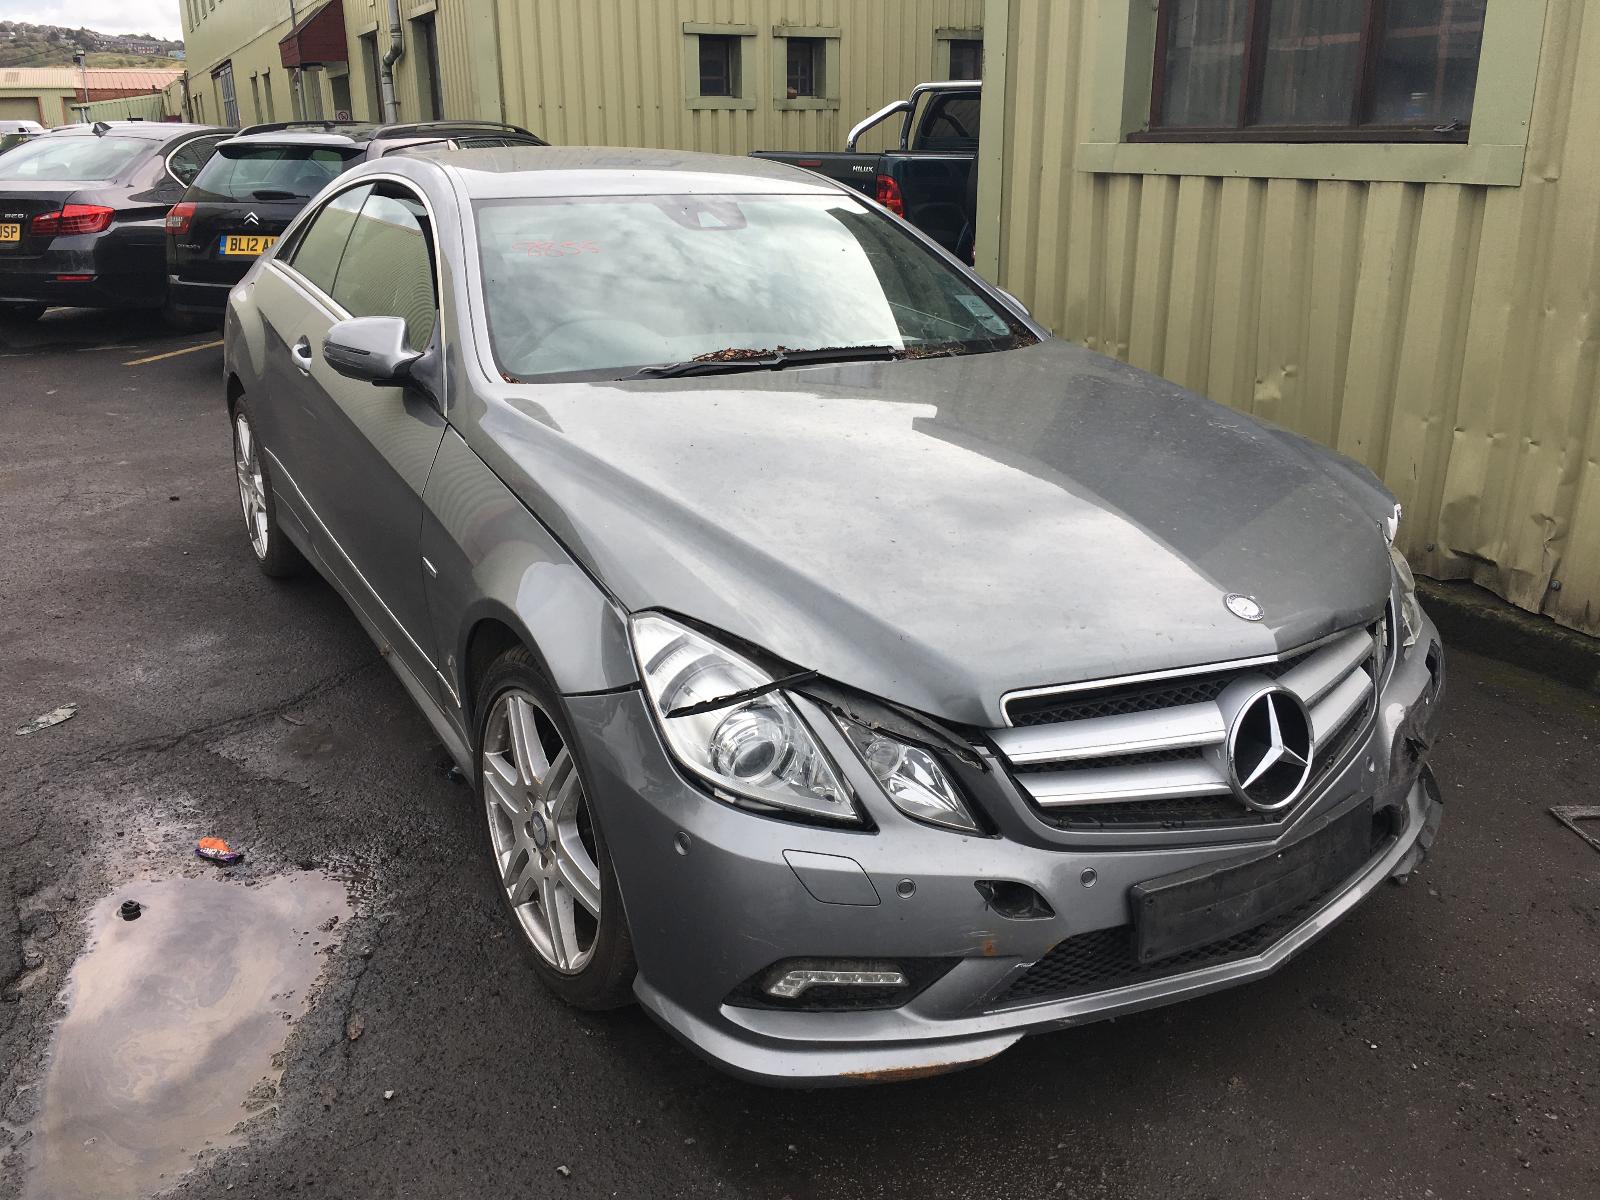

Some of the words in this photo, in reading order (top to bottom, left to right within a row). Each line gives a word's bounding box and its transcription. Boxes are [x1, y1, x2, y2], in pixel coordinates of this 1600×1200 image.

[852, 165, 874, 173] HILUX
[230, 238, 258, 252] BL12
[262, 238, 274, 252] A
